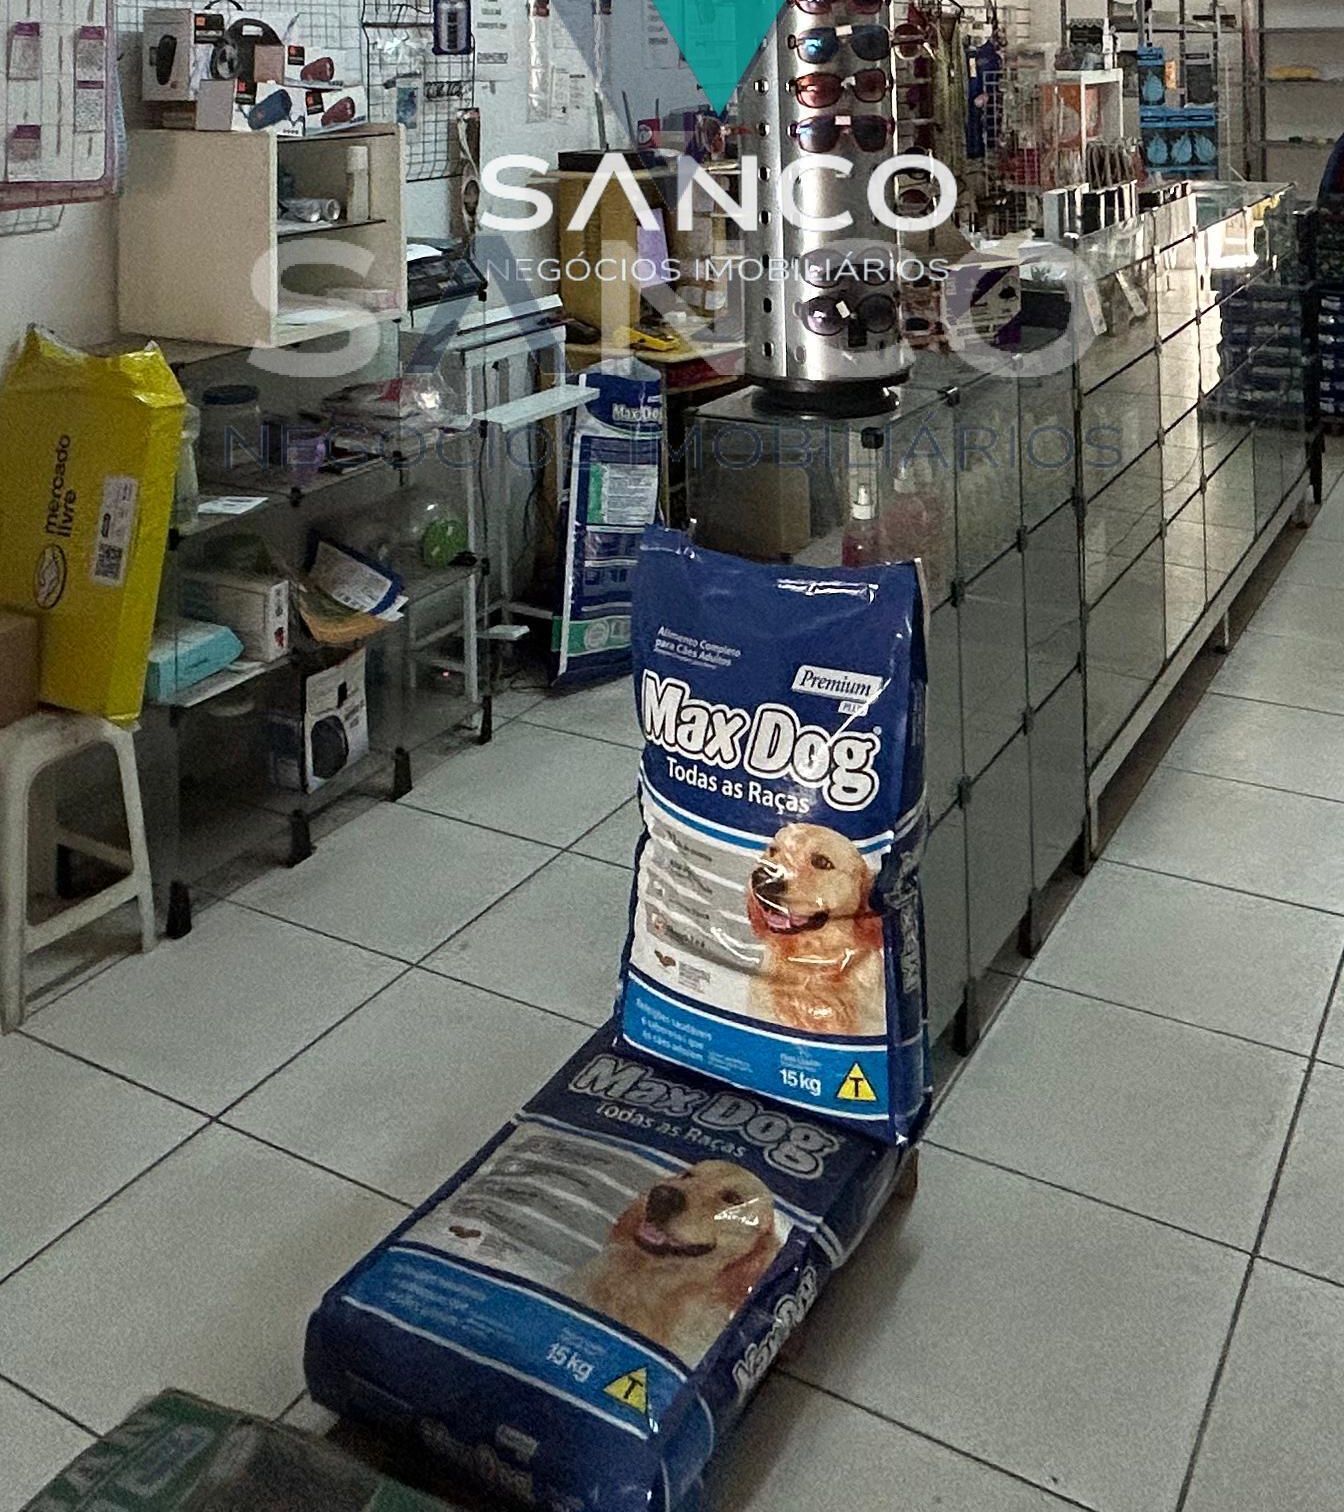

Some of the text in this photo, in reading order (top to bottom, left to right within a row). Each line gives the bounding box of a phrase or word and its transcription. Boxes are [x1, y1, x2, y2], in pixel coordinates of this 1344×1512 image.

[612, 402, 640, 422] Max
[44, 434, 72, 536] mercado
[57, 489, 77, 538] livre
[655, 638, 675, 653] para
[657, 626, 697, 647] Alimento
[800, 668, 872, 697] Premium
[642, 669, 881, 811] Max Dog
[667, 756, 810, 815] Todas as Raças
[568, 1053, 840, 1180] Max Dog
[596, 1101, 656, 1129] Todas
[685, 1128, 747, 1159] Raças
